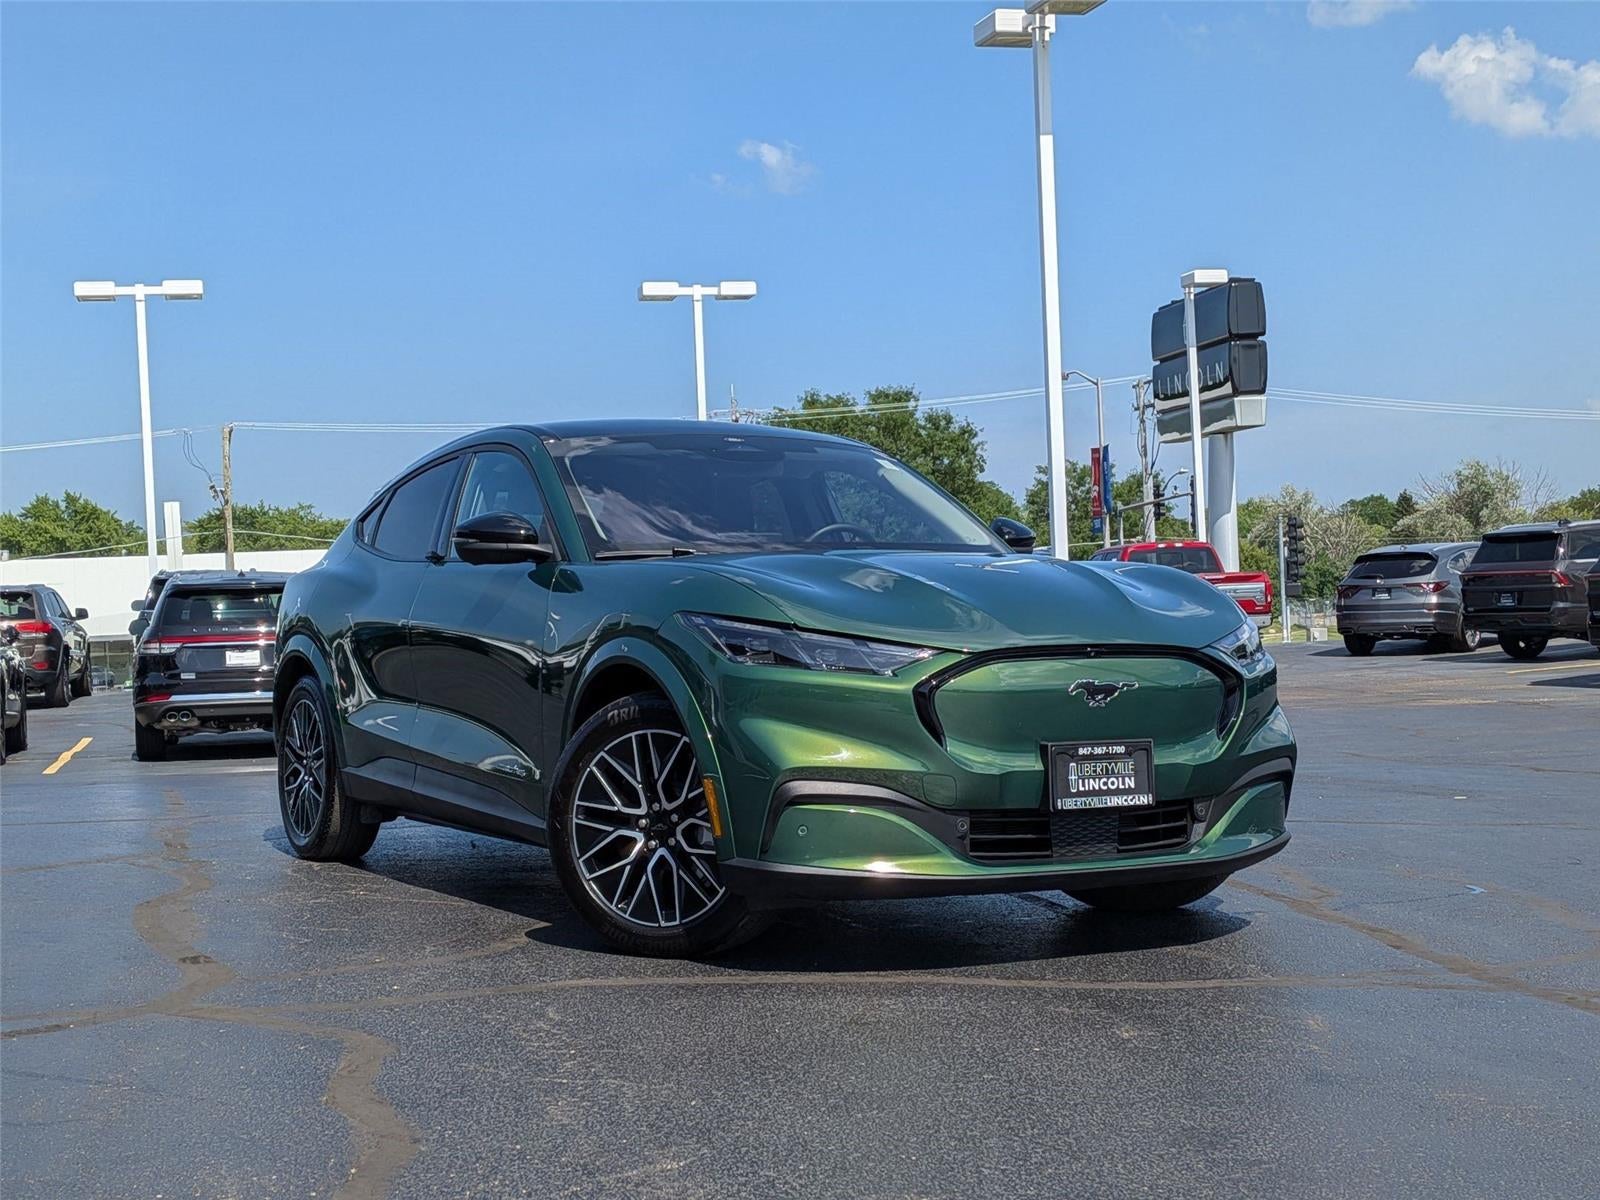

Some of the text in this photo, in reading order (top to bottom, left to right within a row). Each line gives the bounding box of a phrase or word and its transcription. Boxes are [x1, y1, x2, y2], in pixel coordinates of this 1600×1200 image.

[1078, 745, 1126, 755] 847-367-1700
[1078, 761, 1135, 776] LIBERTYVILLE
[1078, 776, 1136, 791] LINCOLN
